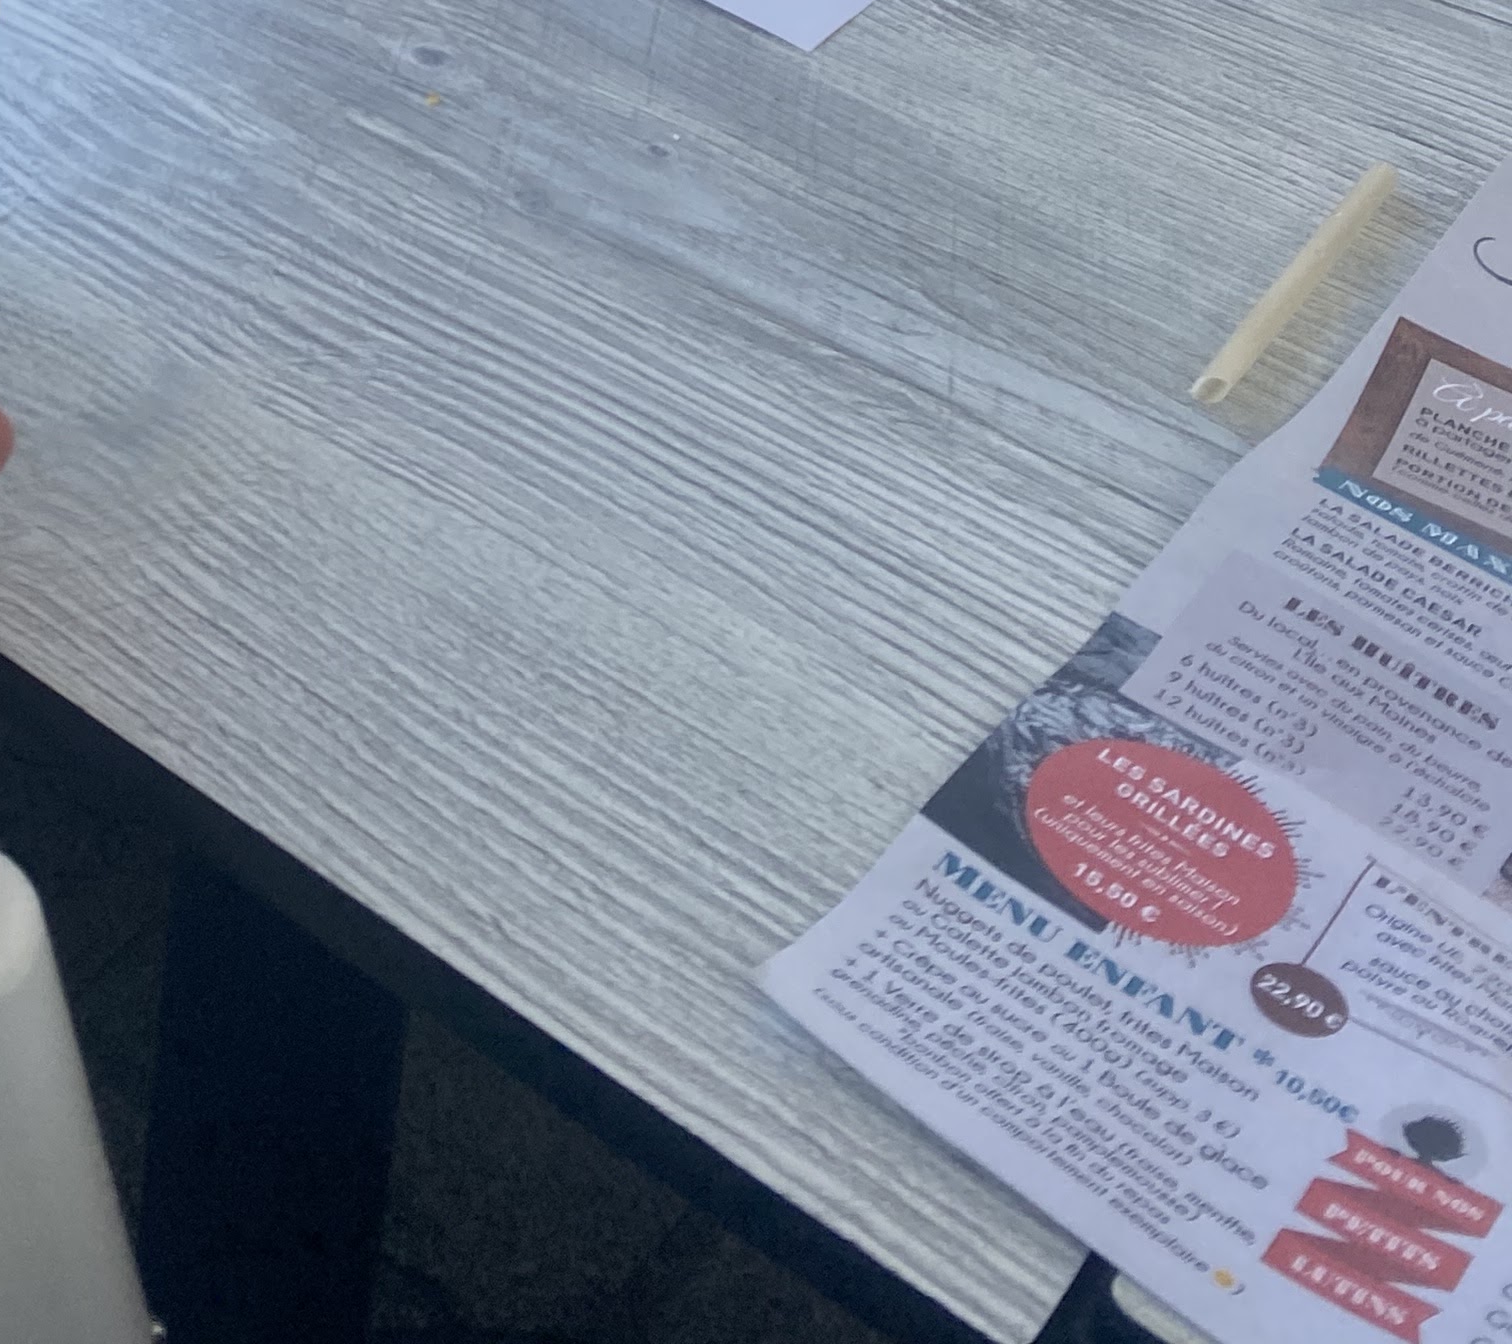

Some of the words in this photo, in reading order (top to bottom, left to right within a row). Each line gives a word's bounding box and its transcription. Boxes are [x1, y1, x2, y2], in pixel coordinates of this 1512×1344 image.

[1402, 443, 1504, 492] RILLETTES
[1420, 406, 1512, 452] PLANCHE
[1396, 457, 1481, 499] PORTION
[1319, 497, 1344, 514] LA
[1350, 515, 1426, 558] SALADE
[1284, 597, 1345, 637] LES
[1291, 527, 1316, 546] LA
[1320, 543, 1396, 589] SALADE
[1401, 589, 1481, 635] CAESAR
[1343, 591, 1421, 639] parmesan
[1445, 648, 1496, 678] sauce
[1166, 671, 1182, 685] 9
[1184, 681, 1250, 722] huîtres
[1178, 653, 1195, 668] 6
[1198, 663, 1262, 704] huîtres
[1205, 640, 1227, 657] du
[1230, 655, 1276, 683] citron
[1277, 682, 1297, 696] et
[1299, 695, 1318, 710] un
[1320, 708, 1387, 754] vinaigre
[1228, 635, 1284, 671] Servies
[1286, 671, 1328, 698] avec
[1330, 696, 1354, 715] du
[1238, 601, 1265, 620] Du
[1363, 677, 1482, 751] provenance
[1331, 675, 1365, 698] aux
[1369, 698, 1437, 743] Moines
[1153, 689, 1182, 709] 12
[1184, 706, 1251, 747] huîtres
[1098, 748, 1145, 781] LES
[1147, 777, 1275, 860] SARDINES
[1114, 782, 1230, 859] GRILLÉES
[1032, 808, 1140, 879] (uniquement
[1141, 878, 1166, 897] en
[1168, 892, 1238, 939] saison)
[1063, 794, 1082, 810] et
[1086, 806, 1125, 835] leurs
[1128, 835, 1172, 864] frites
[1175, 860, 1241, 905] Maison
[1064, 813, 1107, 841] pour
[1109, 839, 1135, 859] les
[1137, 856, 1210, 904] sublimer
[1073, 865, 1136, 910] 15,50
[1139, 903, 1162, 925] €
[1363, 904, 1434, 946] Origine
[933, 851, 1064, 947] MENU
[1063, 939, 1245, 1056] ENFANT
[1341, 959, 1408, 996] poivre
[1369, 957, 1430, 991] sauce
[1375, 931, 1425, 960] avec
[889, 914, 913, 932] ou
[916, 927, 1045, 1014] Moules-frites
[1051, 1011, 1131, 1071] (400g)
[901, 901, 925, 918] ou
[930, 915, 1009, 969] Galette
[1012, 966, 1092, 1021] jambon
[1096, 1019, 1188, 1084] fromage
[915, 882, 1004, 942] Nuggets
[1006, 940, 1038, 964] de
[1038, 963, 1114, 1014] poulet,
[1120, 1012, 1171, 1049] frites
[1177, 1045, 1259, 1102] Maison
[1256, 973, 1324, 1021] 22,90
[857, 942, 963, 1011] artisanale
[1097, 1096, 1192, 1166] chocolat)
[885, 982, 940, 1024] Verre
[943, 1021, 975, 1047] de
[977, 1047, 1031, 1089] sirop
[1056, 1096, 1116, 1143] l'eau
[891, 940, 958, 987] Crêpe
[960, 987, 987, 1006] au
[991, 1005, 1047, 1044] sucre
[1049, 1044, 1075, 1063] ou
[1098, 1072, 1161, 1121] Boule
[1163, 1119, 1198, 1145] de
[1199, 1146, 1268, 1191] glace
[858, 1022, 939, 1081] condition
[1109, 1196, 1210, 1273] exemplaire
[1090, 1161, 1115, 1181] du
[1116, 1182, 1170, 1224] repas
